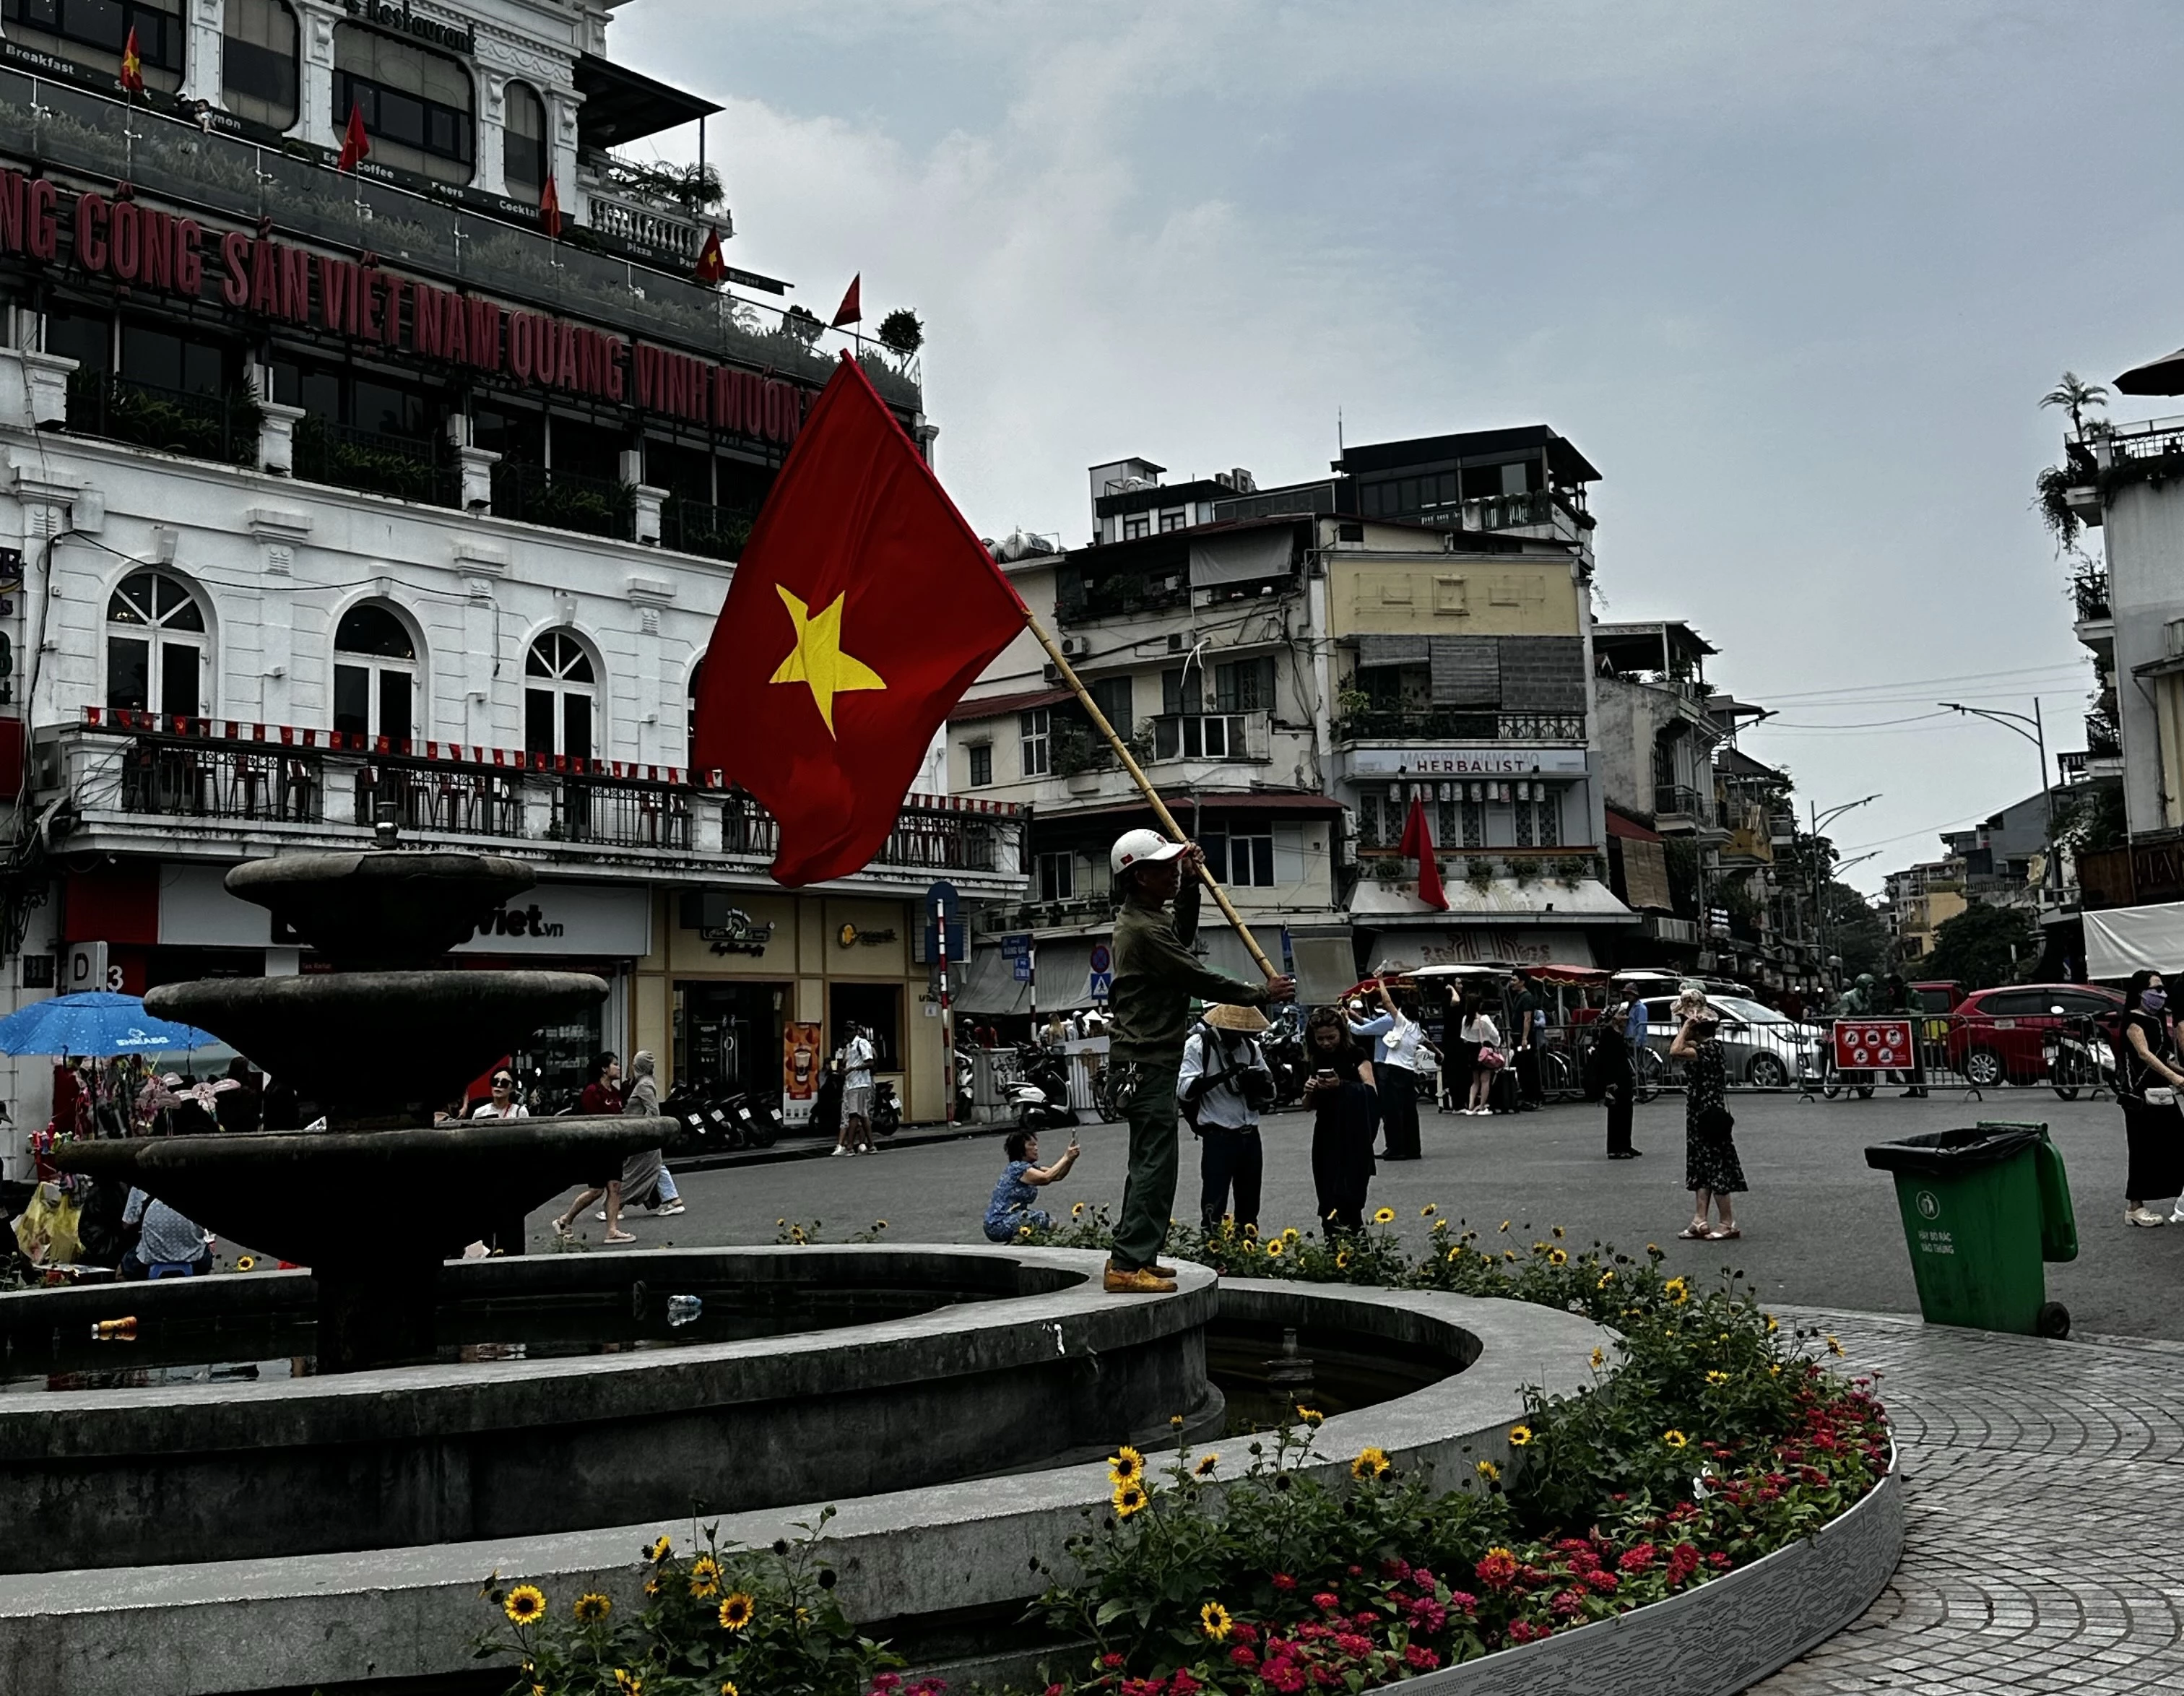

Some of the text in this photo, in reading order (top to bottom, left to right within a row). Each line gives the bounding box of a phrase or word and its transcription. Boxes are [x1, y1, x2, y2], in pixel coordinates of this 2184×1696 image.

[367, 0, 477, 55] Restaurant
[5, 43, 75, 75] Breakfast
[113, 79, 152, 101] Stk
[357, 160, 395, 179] Coffee
[498, 199, 540, 219] Cocktai
[626, 241, 653, 257] Pizza
[728, 270, 760, 286] Burger
[75, 181, 203, 301] CỘNG
[220, 216, 310, 324] SẢN
[318, 250, 405, 358] VIỆT
[412, 282, 500, 372] NAM
[507, 310, 625, 403] QUANG
[632, 340, 708, 425] VINH
[1416, 760, 1525, 771] HERBALIST
